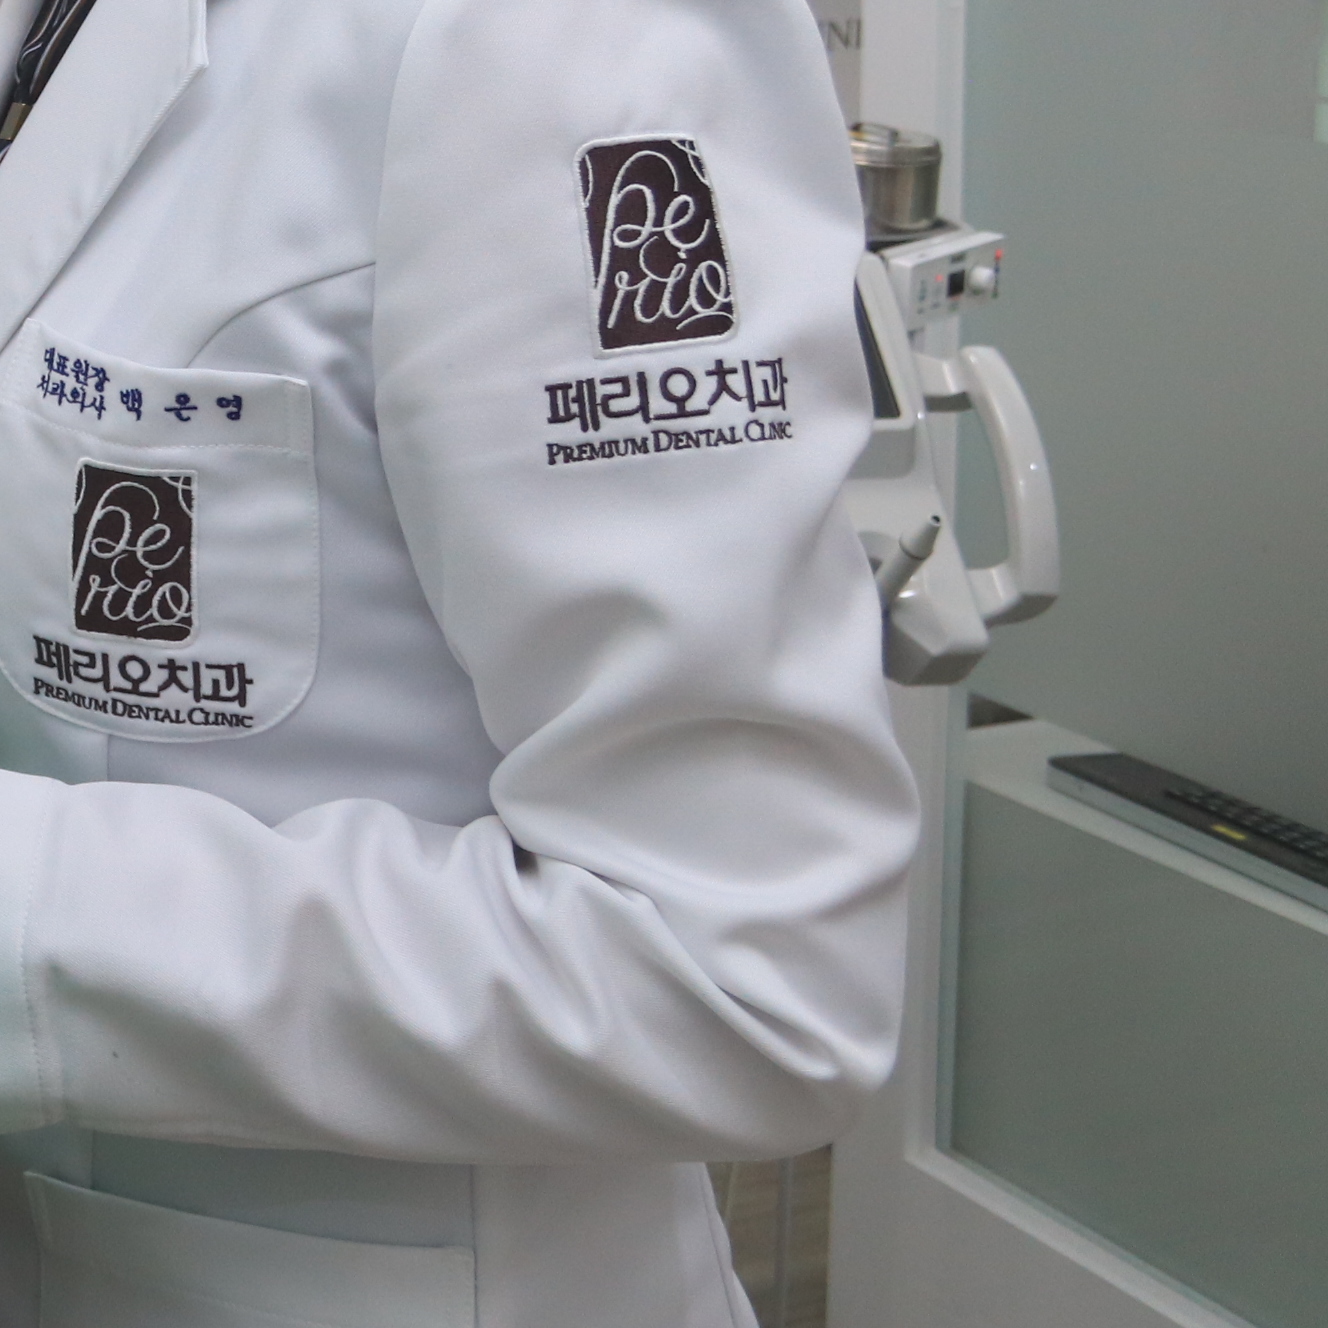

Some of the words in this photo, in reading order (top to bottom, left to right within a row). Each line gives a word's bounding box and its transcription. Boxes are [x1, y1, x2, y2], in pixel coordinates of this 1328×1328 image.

[44, 347, 110, 393] 대표원장
[544, 357, 788, 432] 페리오치과
[546, 436, 649, 466] PREMIUM
[652, 426, 742, 452] DENTAL
[33, 635, 254, 708] 페리오치과
[33, 677, 108, 714] PREMIUM
[111, 698, 186, 724] DENTAL
